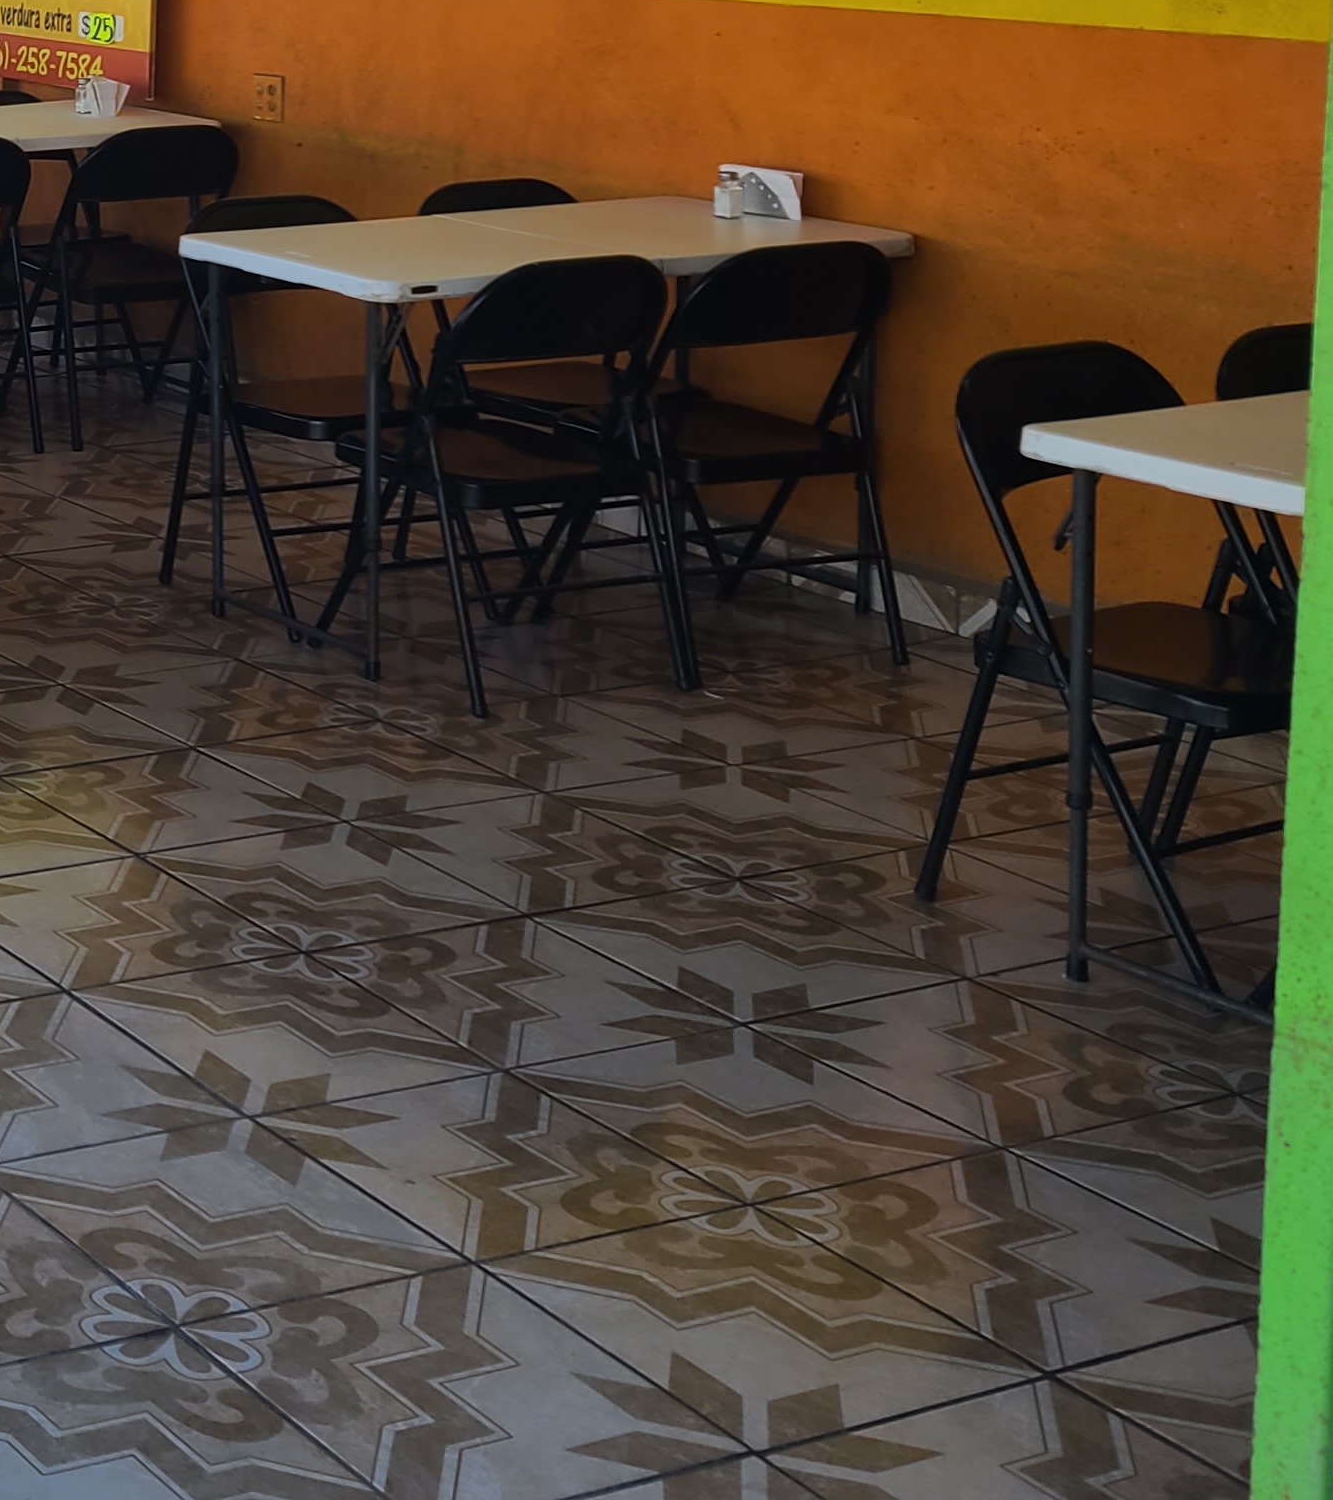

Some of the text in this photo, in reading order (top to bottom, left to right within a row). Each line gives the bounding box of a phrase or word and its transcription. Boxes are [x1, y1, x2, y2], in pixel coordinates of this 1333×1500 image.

[0, 3, 113, 43] verdura extra $25
